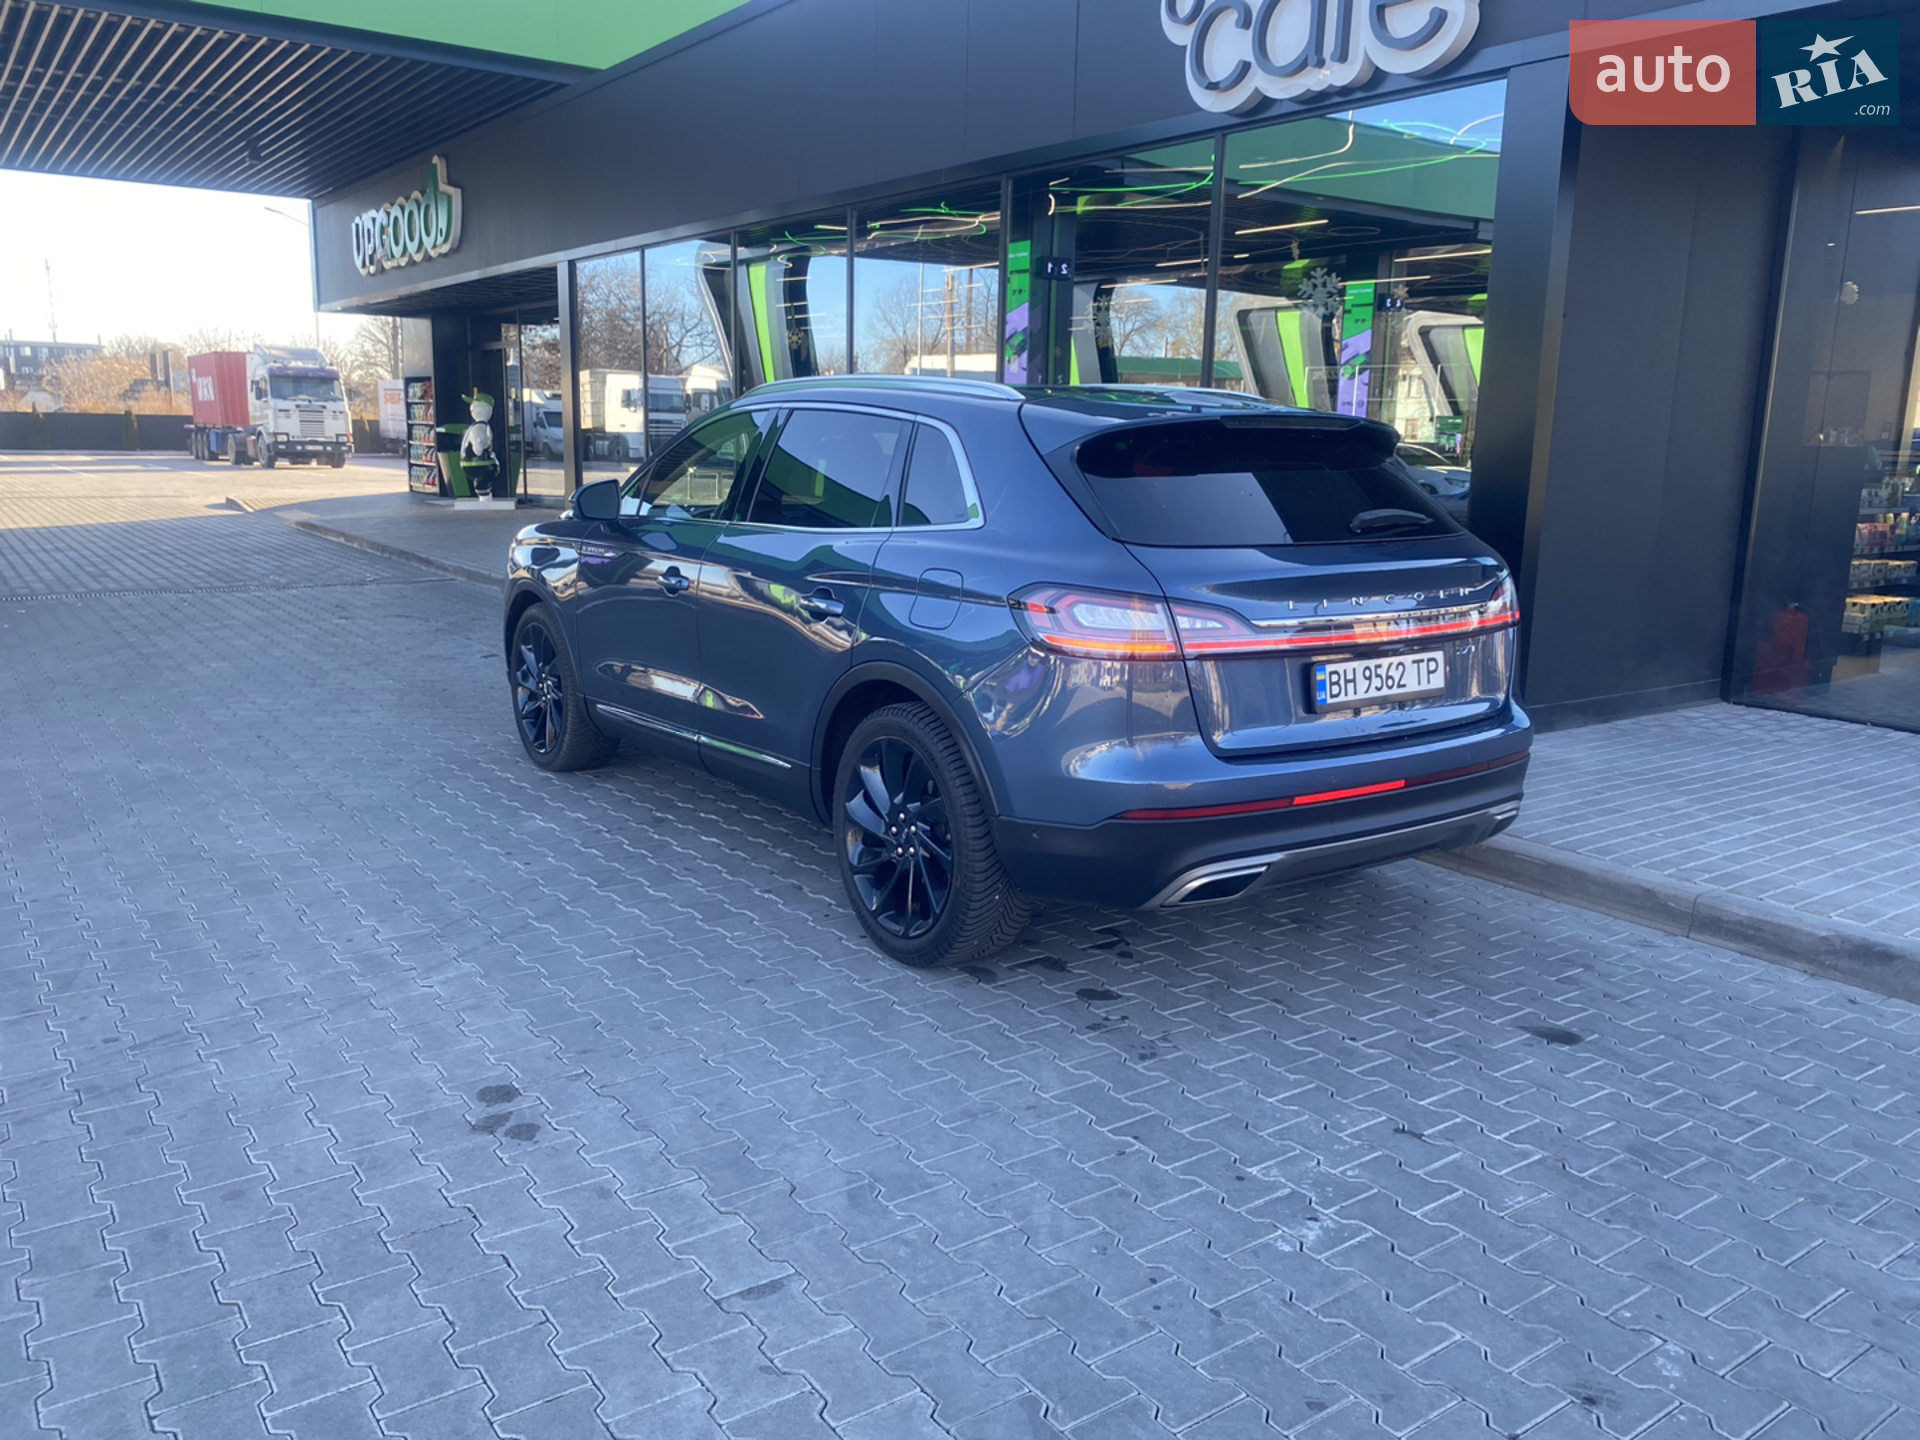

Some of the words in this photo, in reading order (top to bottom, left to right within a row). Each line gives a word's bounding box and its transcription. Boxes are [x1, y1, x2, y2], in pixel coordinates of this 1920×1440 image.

[1289, 588, 1470, 610] LINCOLN
[1328, 668, 1357, 699] BH
[1362, 661, 1407, 694] 9562
[1412, 657, 1439, 686] TP
[1316, 690, 1327, 701] UA
